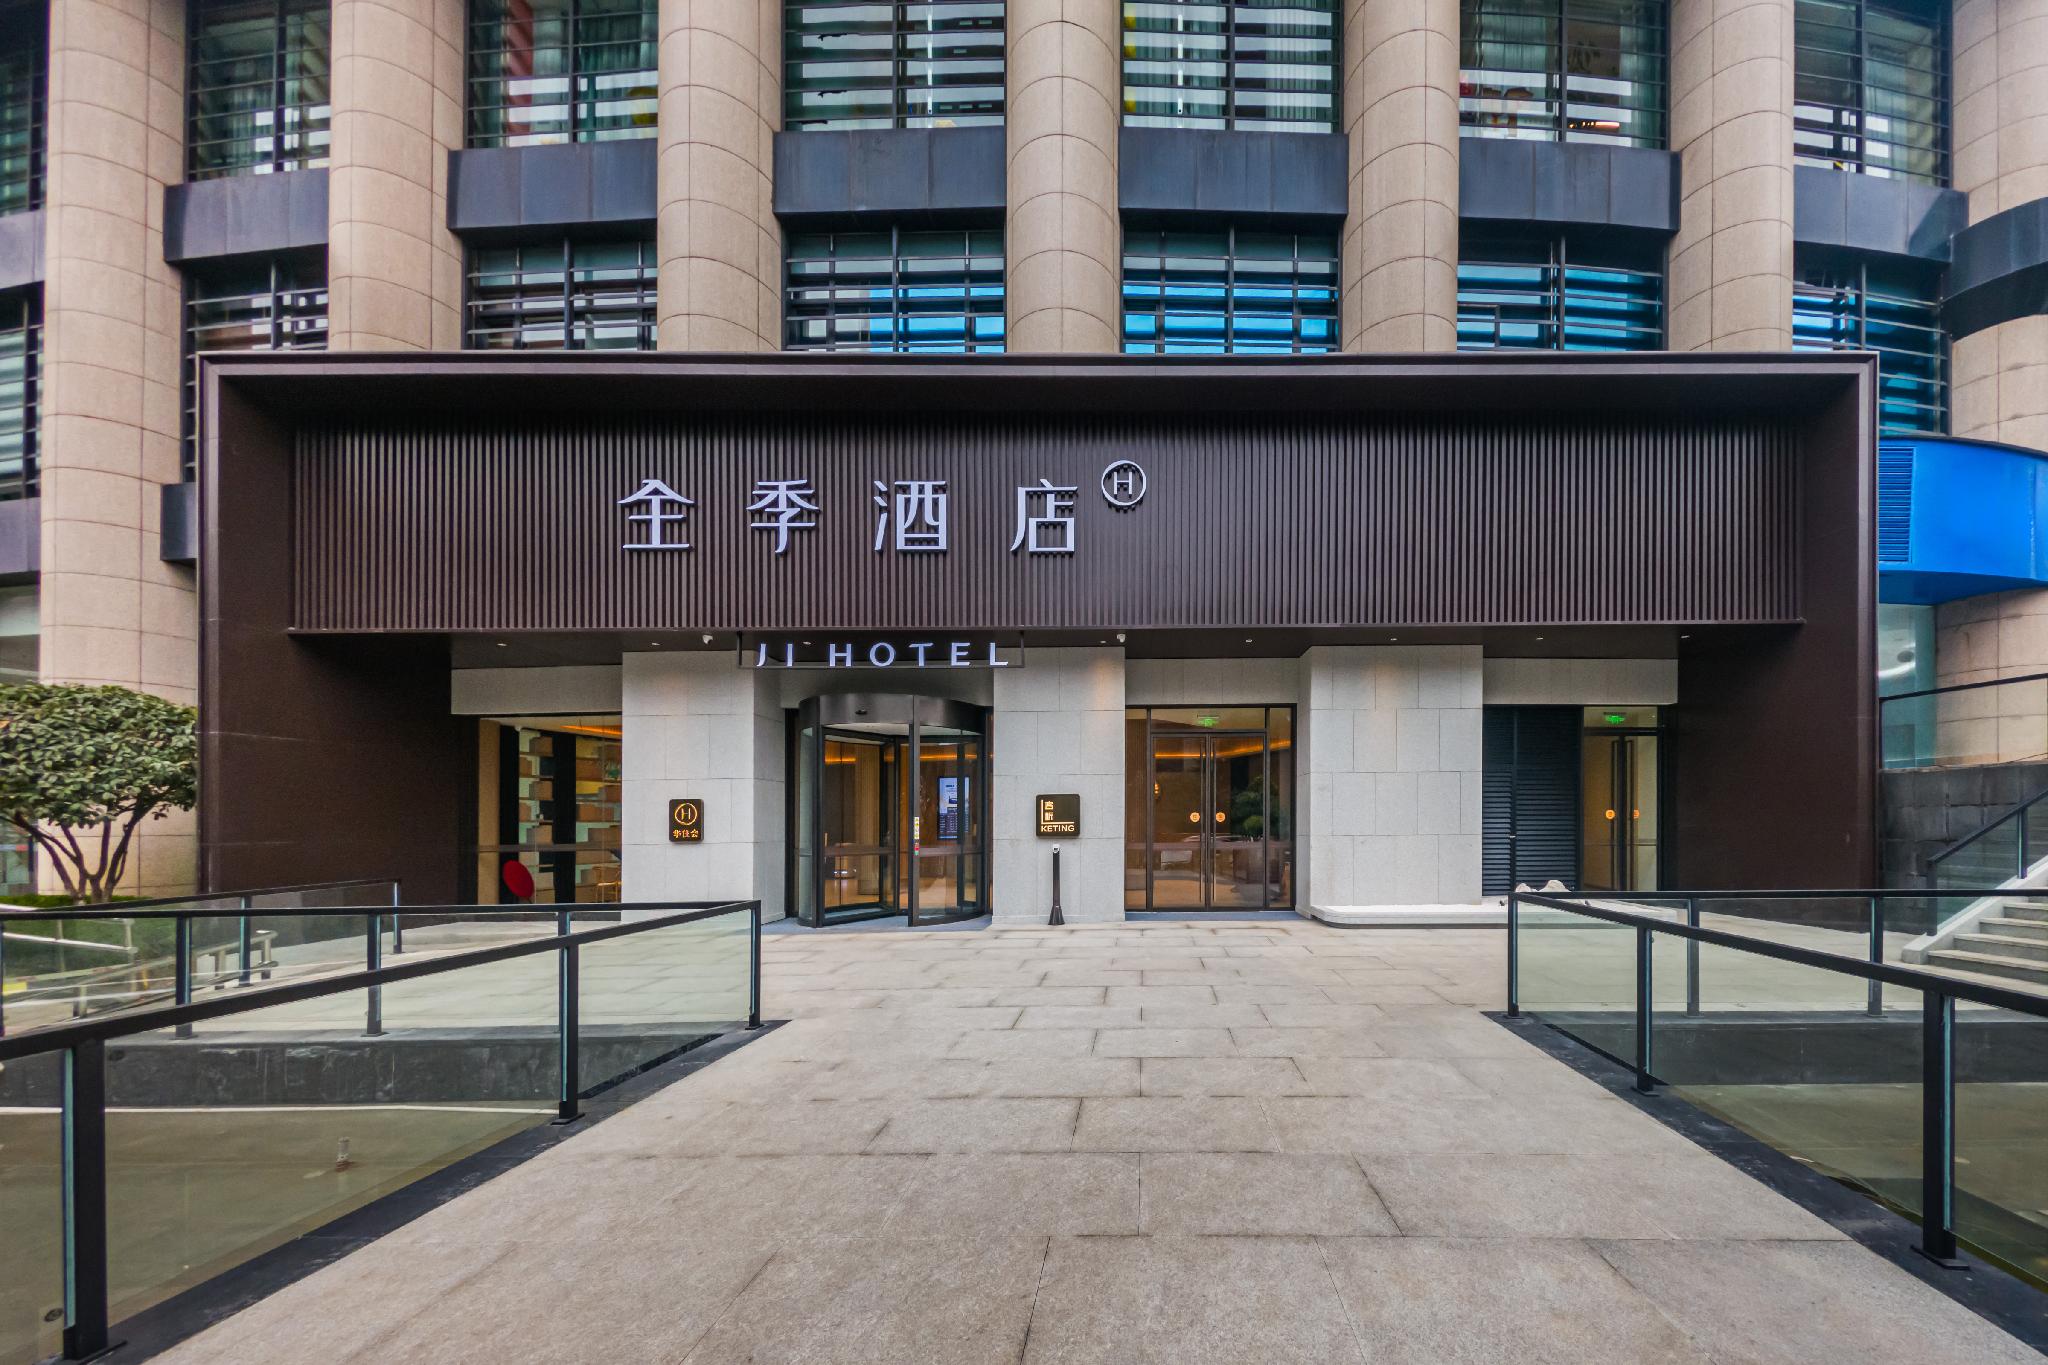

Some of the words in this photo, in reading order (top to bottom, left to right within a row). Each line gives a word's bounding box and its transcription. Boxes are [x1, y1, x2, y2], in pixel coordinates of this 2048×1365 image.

[617, 479, 1078, 554] 全季酒店
[756, 643, 794, 667] JI
[828, 642, 1009, 667] HOTEL
[1040, 824, 1075, 832] KETING
